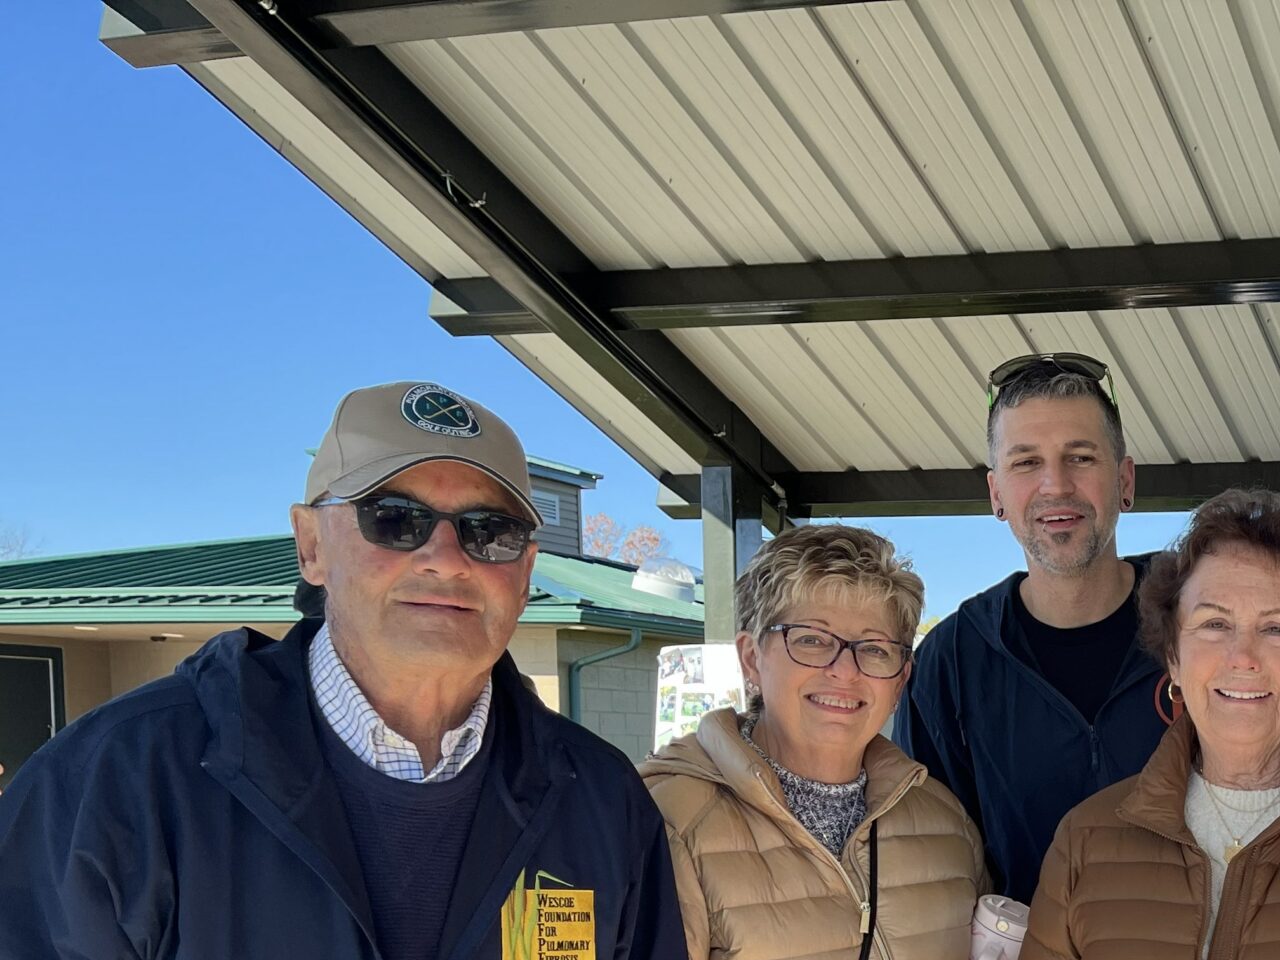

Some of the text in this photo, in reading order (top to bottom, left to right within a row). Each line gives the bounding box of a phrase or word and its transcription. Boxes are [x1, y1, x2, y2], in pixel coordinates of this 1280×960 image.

[537, 894, 575, 908] WESCOE
[537, 908, 591, 923] FOUNDATION
[537, 923, 557, 937] FOR
[538, 937, 591, 951] PULMONARY
